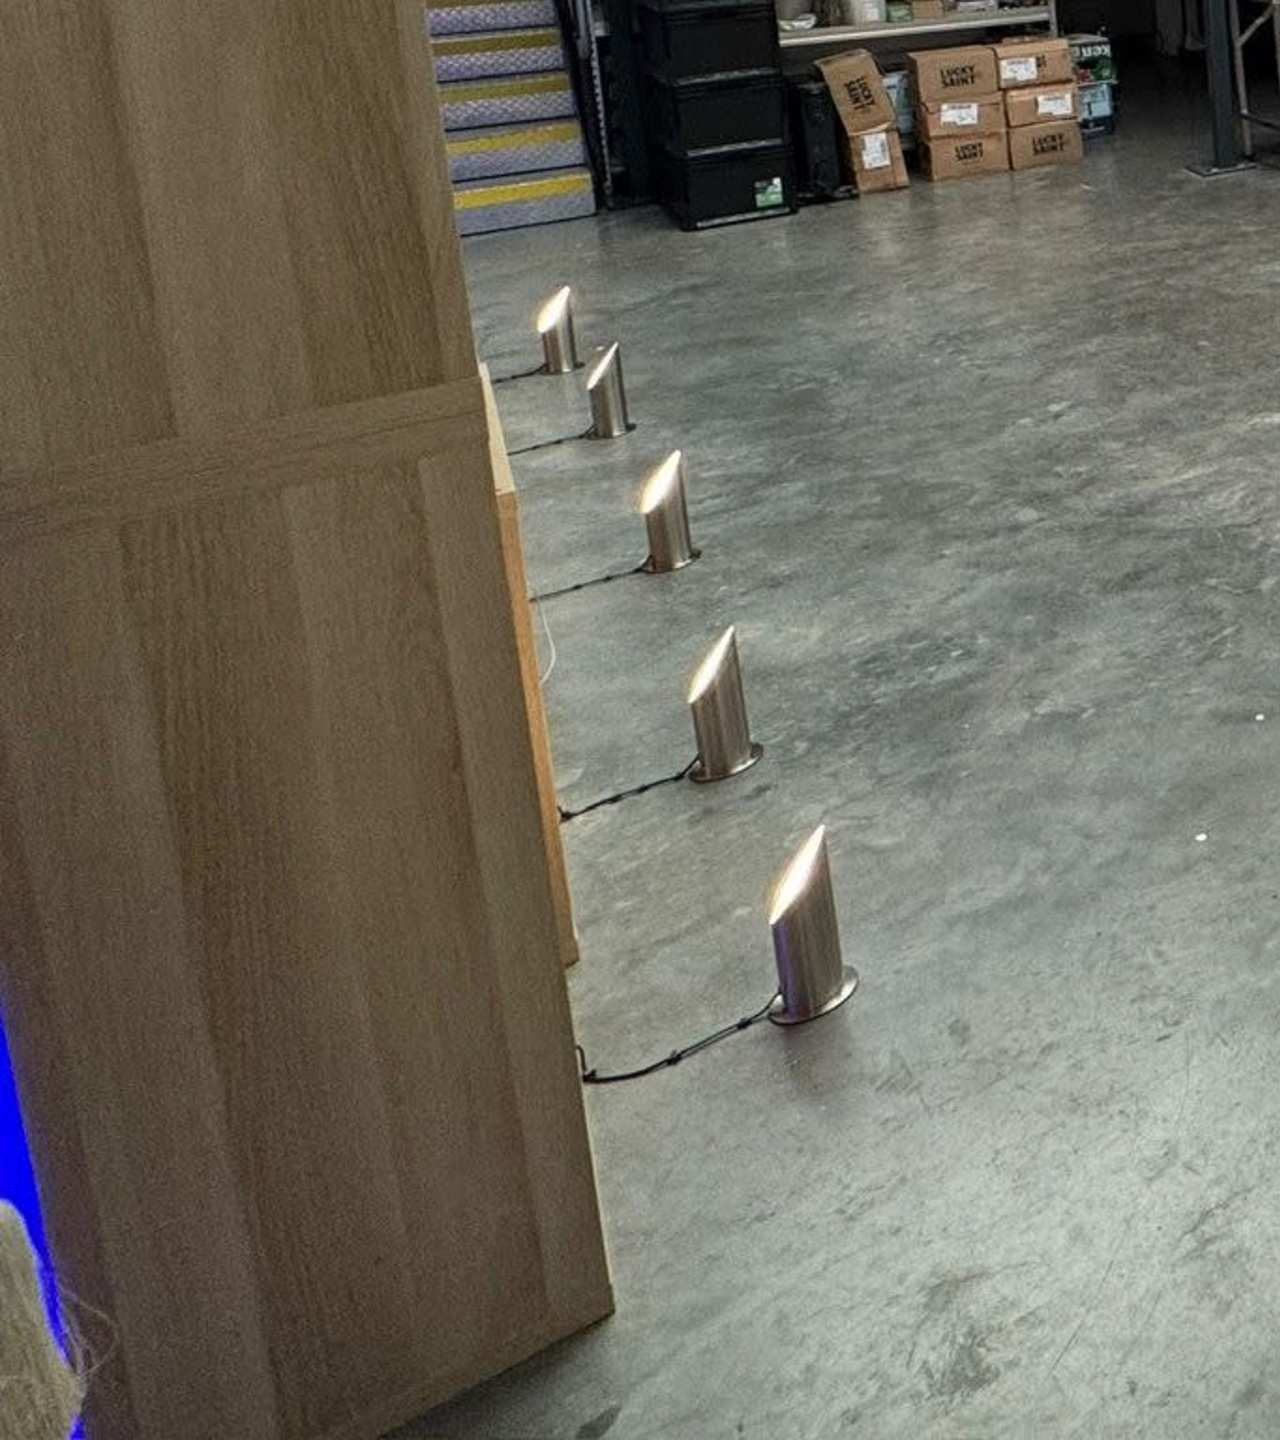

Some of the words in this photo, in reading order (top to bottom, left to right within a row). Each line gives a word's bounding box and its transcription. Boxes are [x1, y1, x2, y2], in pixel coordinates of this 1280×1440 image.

[940, 65, 975, 79] LUCKY
[941, 75, 975, 89] SAINT
[1031, 133, 1064, 145] LUCKY
[954, 142, 983, 152] LUCKY
[1032, 143, 1064, 156] SAINT
[955, 148, 984, 161] SAINT
